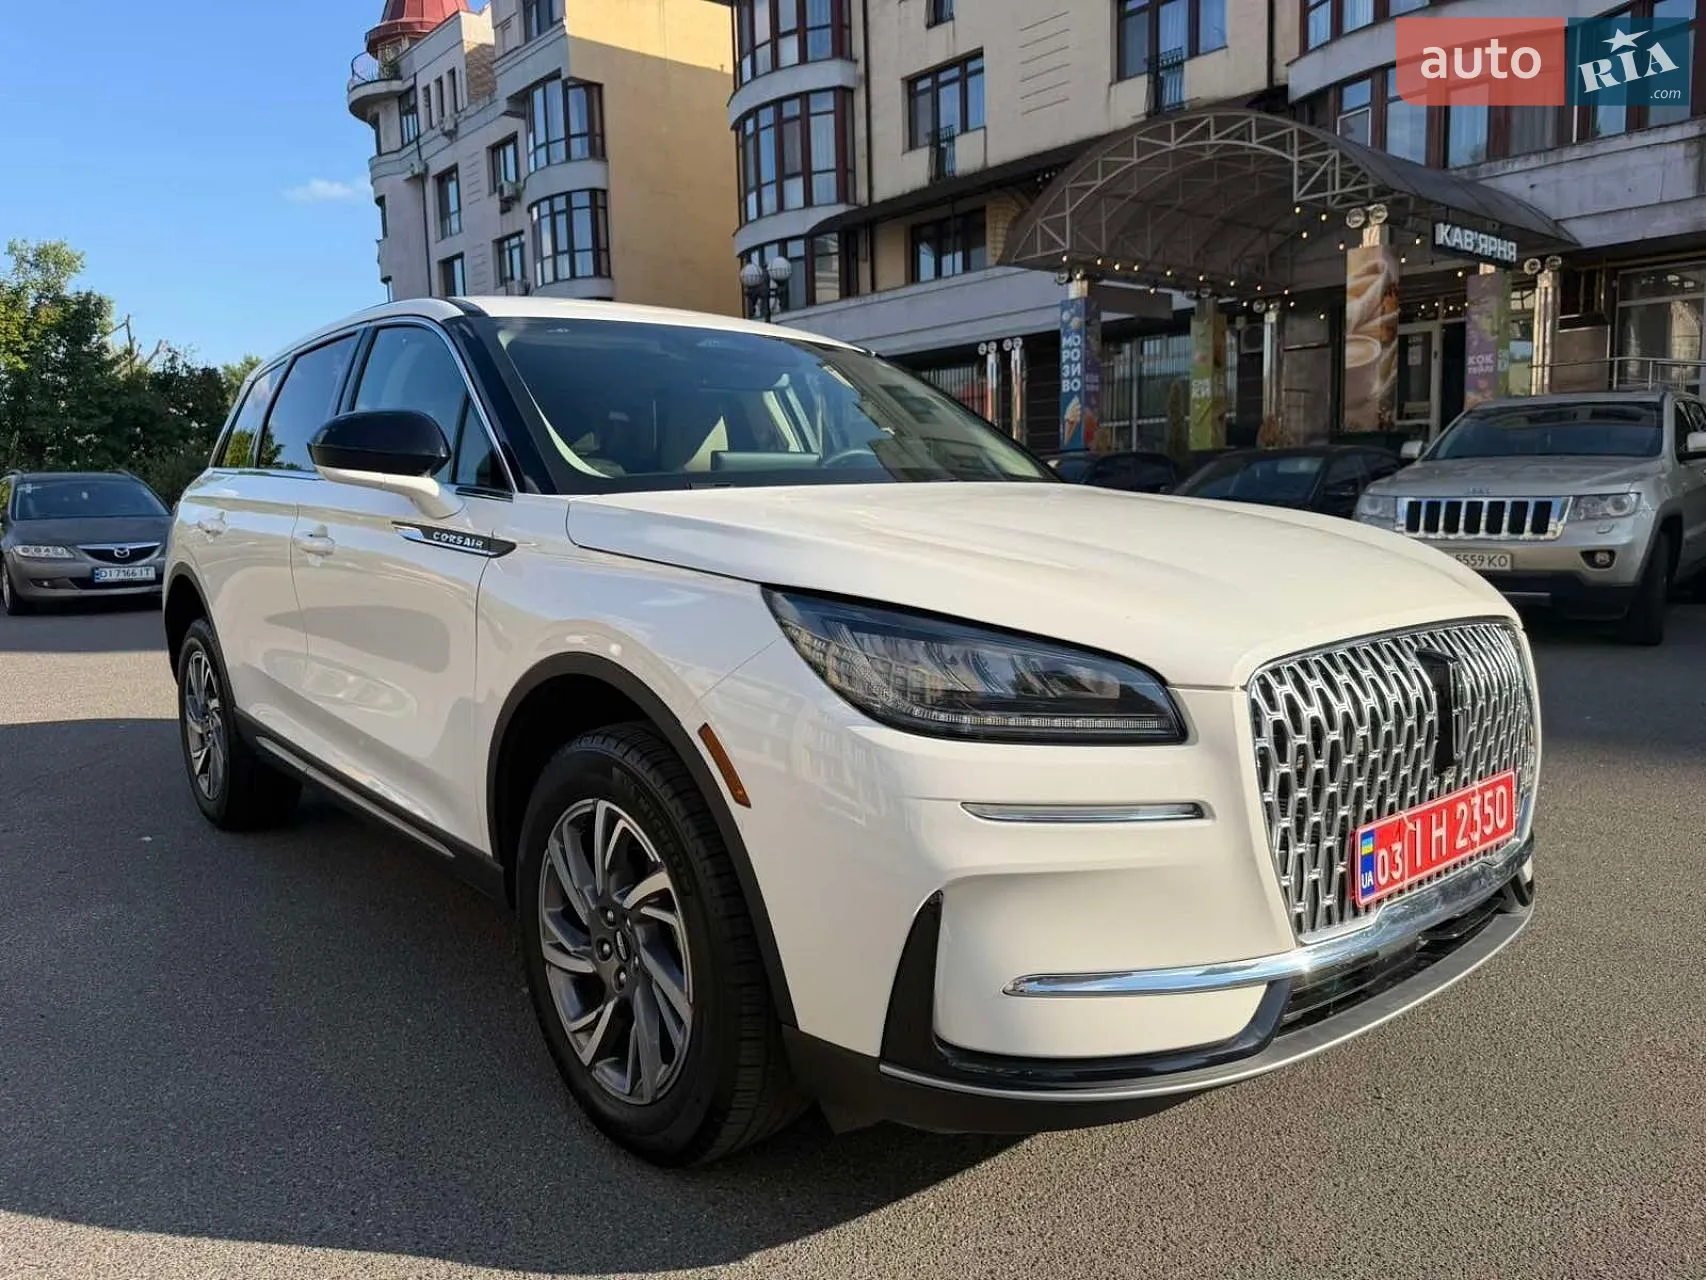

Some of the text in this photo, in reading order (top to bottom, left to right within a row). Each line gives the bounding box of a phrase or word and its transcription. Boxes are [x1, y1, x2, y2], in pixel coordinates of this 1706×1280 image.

[1434, 222, 1517, 263] КАВ'ЯРНЯ
[432, 531, 485, 548] CORSAIR
[1487, 554, 1509, 568] KO
[1377, 841, 1403, 886] 03
[1455, 784, 1508, 850] 2350
[1361, 870, 1374, 889] UA
